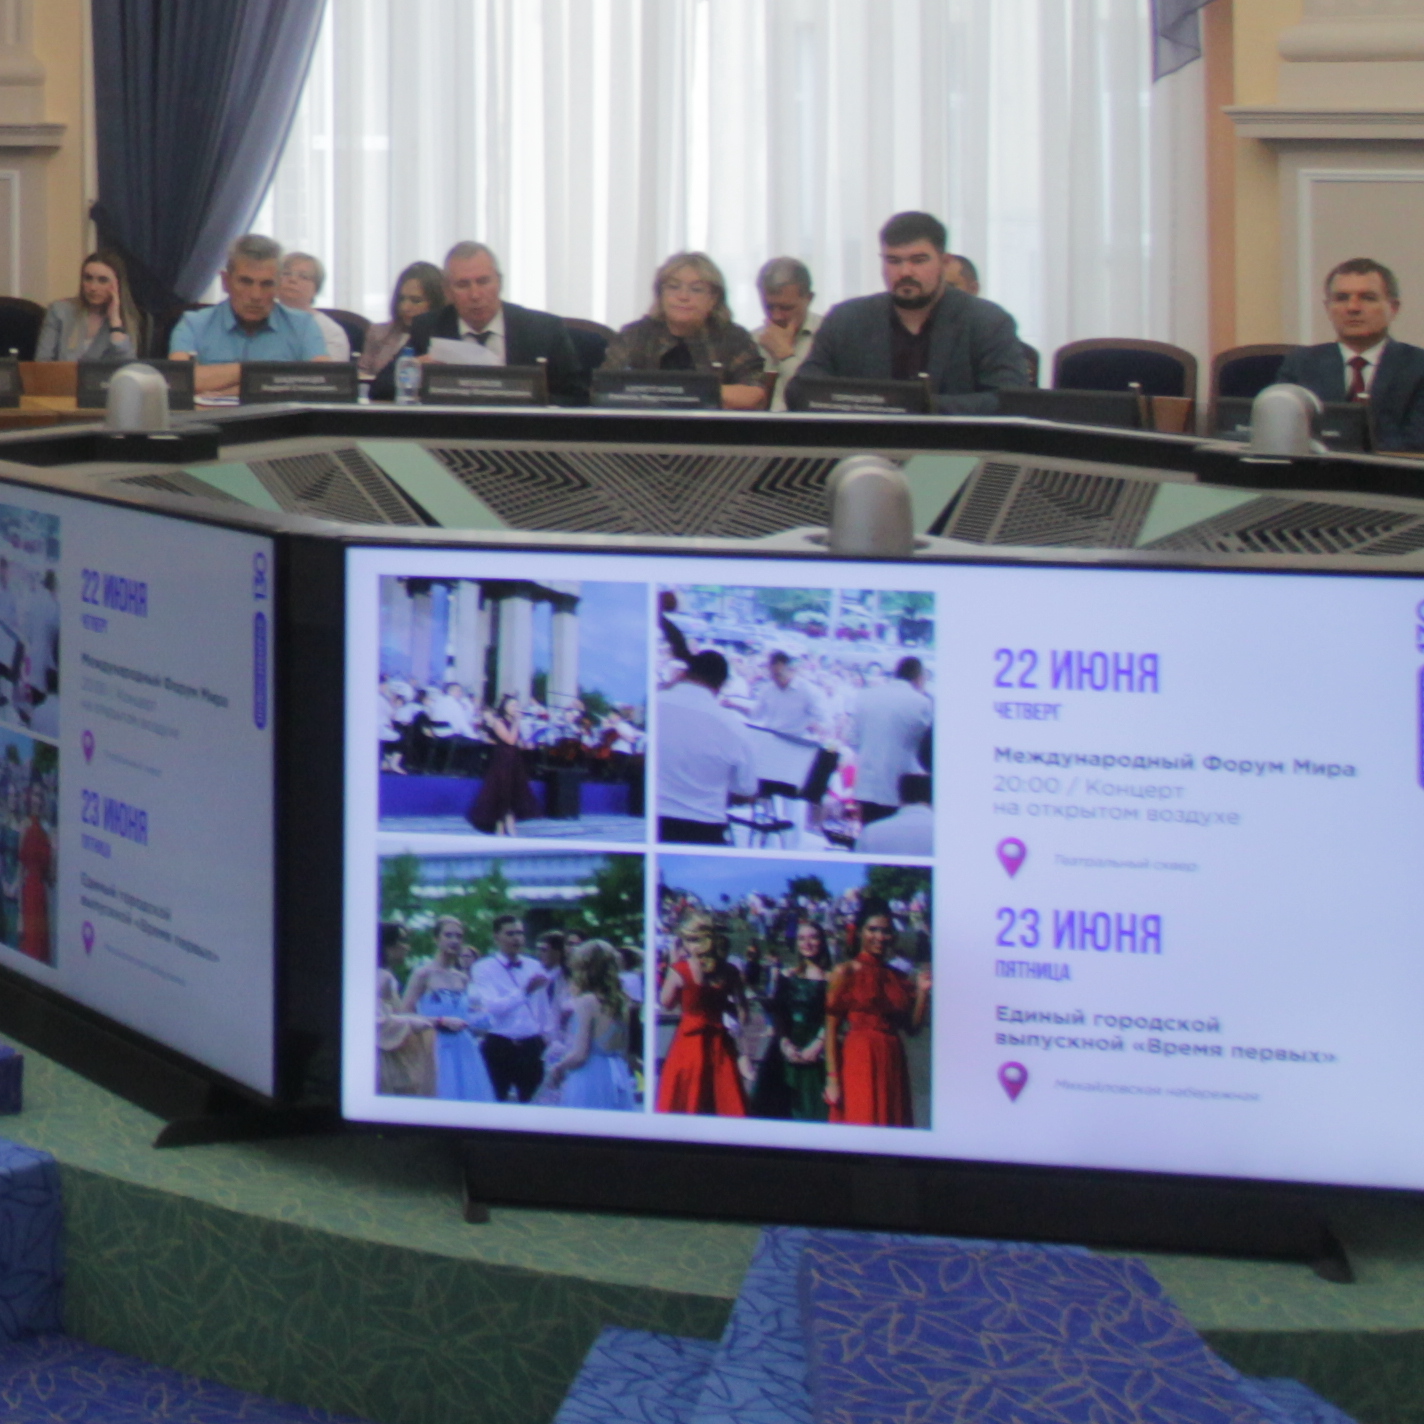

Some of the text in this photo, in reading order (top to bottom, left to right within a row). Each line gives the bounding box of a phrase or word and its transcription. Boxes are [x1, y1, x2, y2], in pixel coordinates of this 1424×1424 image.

[81, 567, 100, 606] 22
[994, 648, 1159, 694] 22 ИЮНЯ
[993, 701, 1062, 721] ЧЕТВЕРГ
[993, 747, 1358, 779] Международный Форум Мира
[993, 774, 1060, 794] 20:00
[1085, 777, 1185, 800] Концерт
[81, 788, 100, 828] 23
[993, 801, 1241, 827] на открытом воздухе
[995, 906, 1162, 955] 23 ИЮНЯ
[995, 959, 1071, 981] ПЯТНИЦА
[995, 1005, 1221, 1033] Единый городской
[994, 1030, 1337, 1064] выпускной «Время первых»
